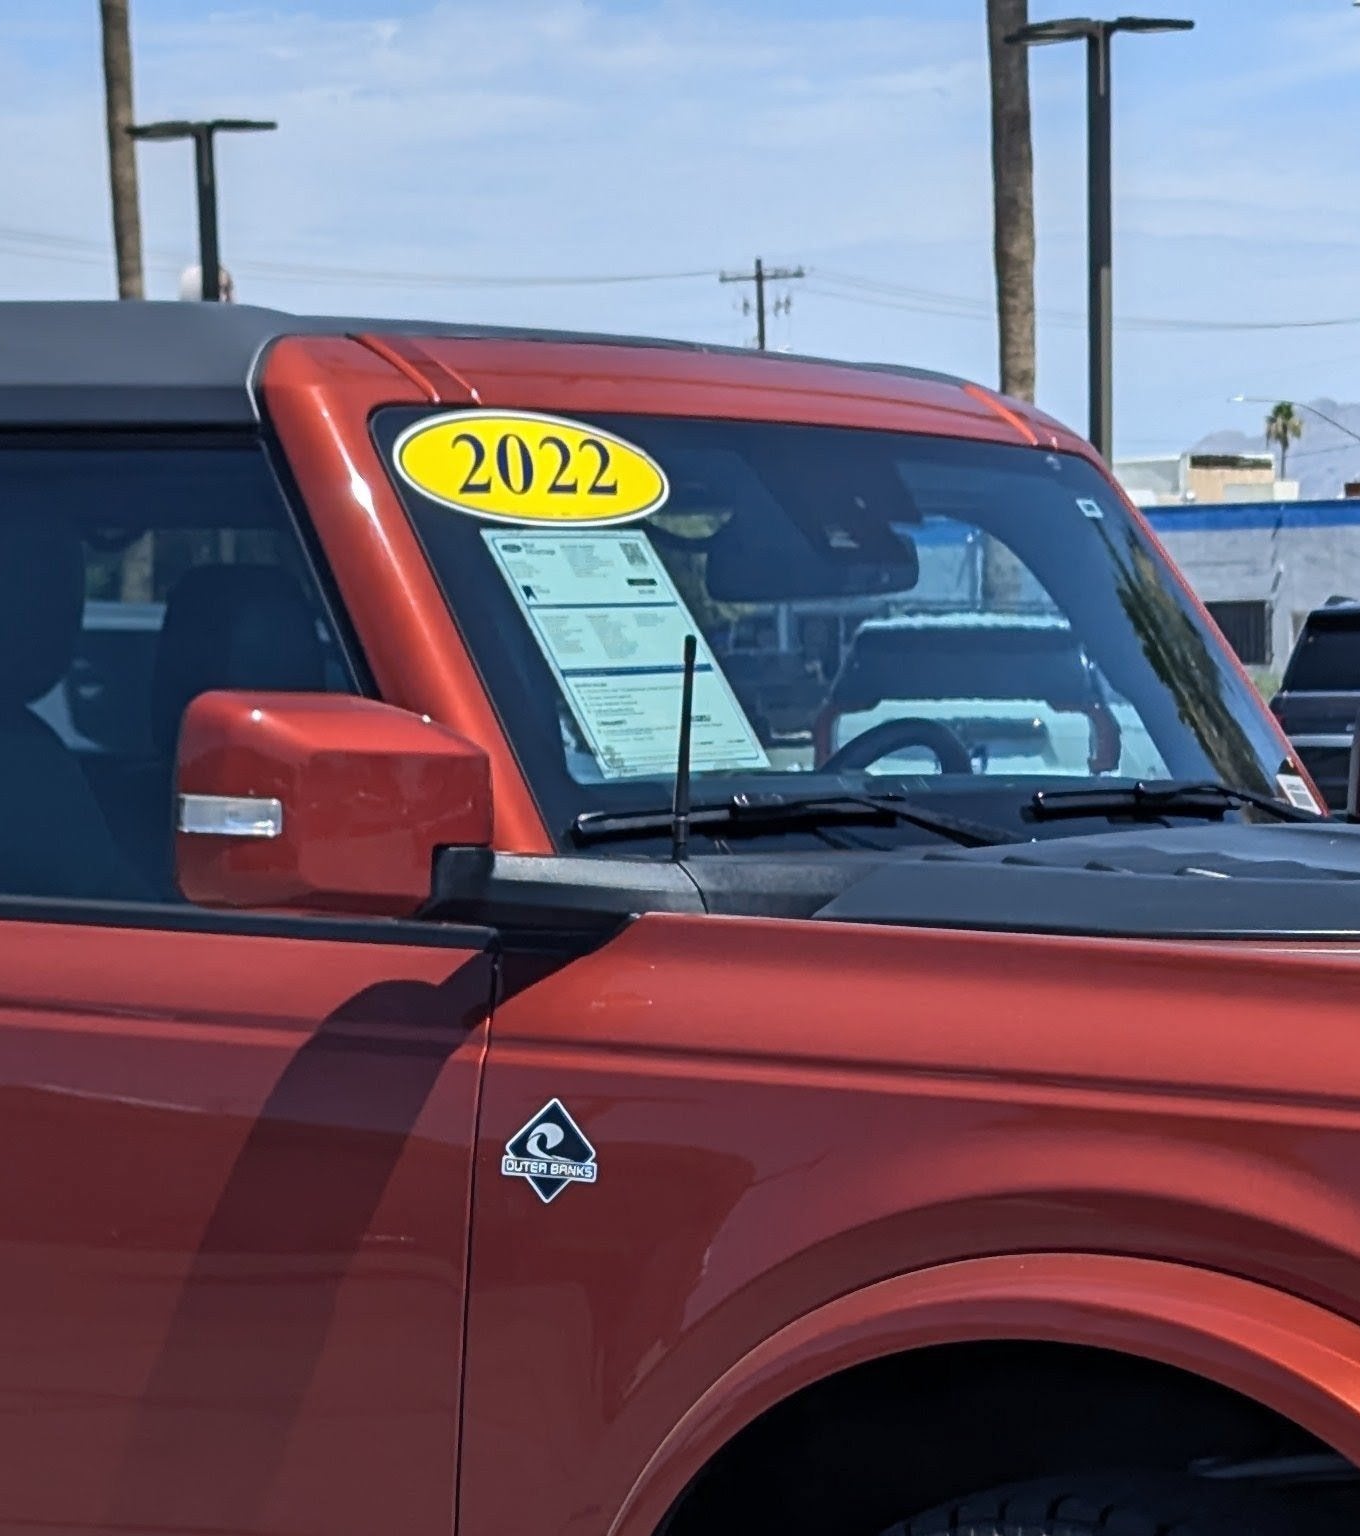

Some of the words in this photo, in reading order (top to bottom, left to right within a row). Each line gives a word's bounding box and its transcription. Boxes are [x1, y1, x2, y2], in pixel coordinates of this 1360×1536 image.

[450, 432, 619, 496] 2022
[506, 1160, 548, 1174] OUTER
[550, 1163, 593, 1178] BANKS
